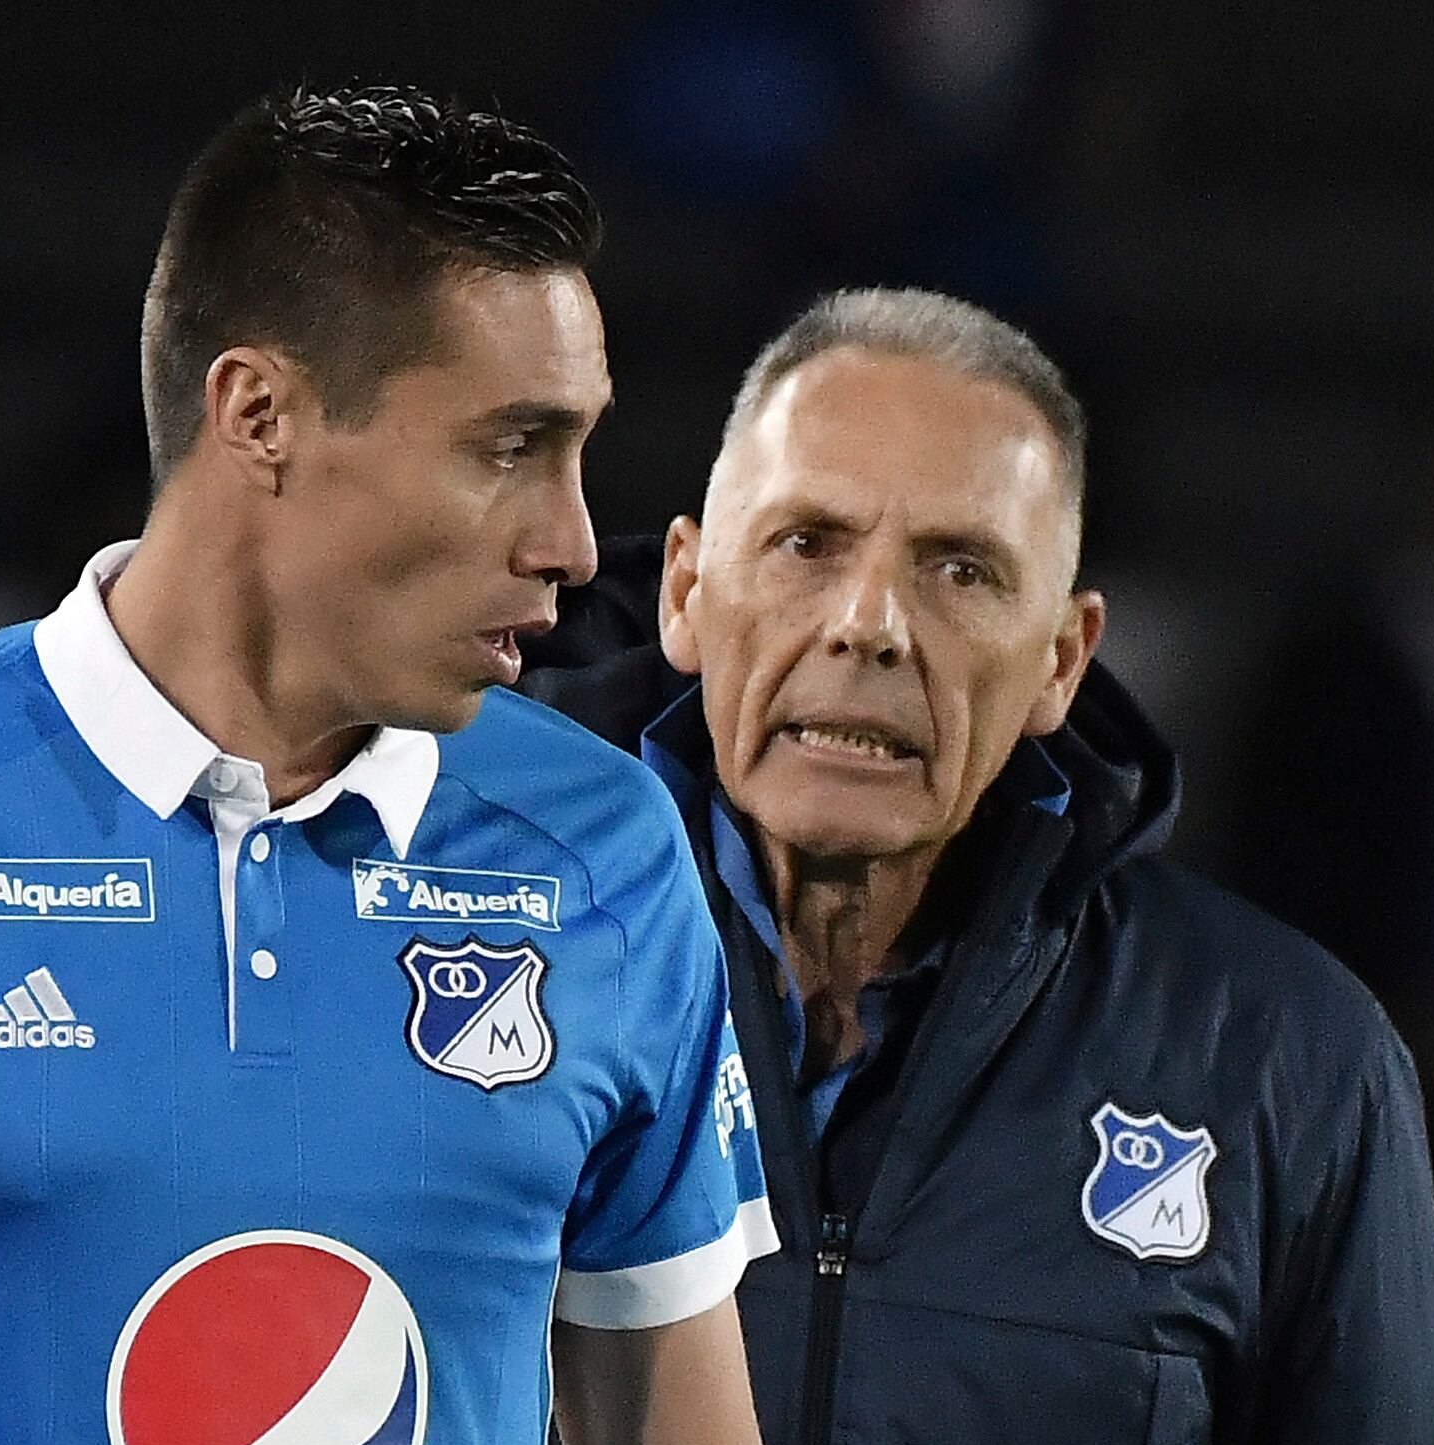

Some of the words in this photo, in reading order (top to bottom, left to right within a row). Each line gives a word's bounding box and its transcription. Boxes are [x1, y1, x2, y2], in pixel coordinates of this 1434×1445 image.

[408, 879, 550, 922] Alquería
[488, 1021, 526, 1057] M
[1150, 1199, 1184, 1237] M
